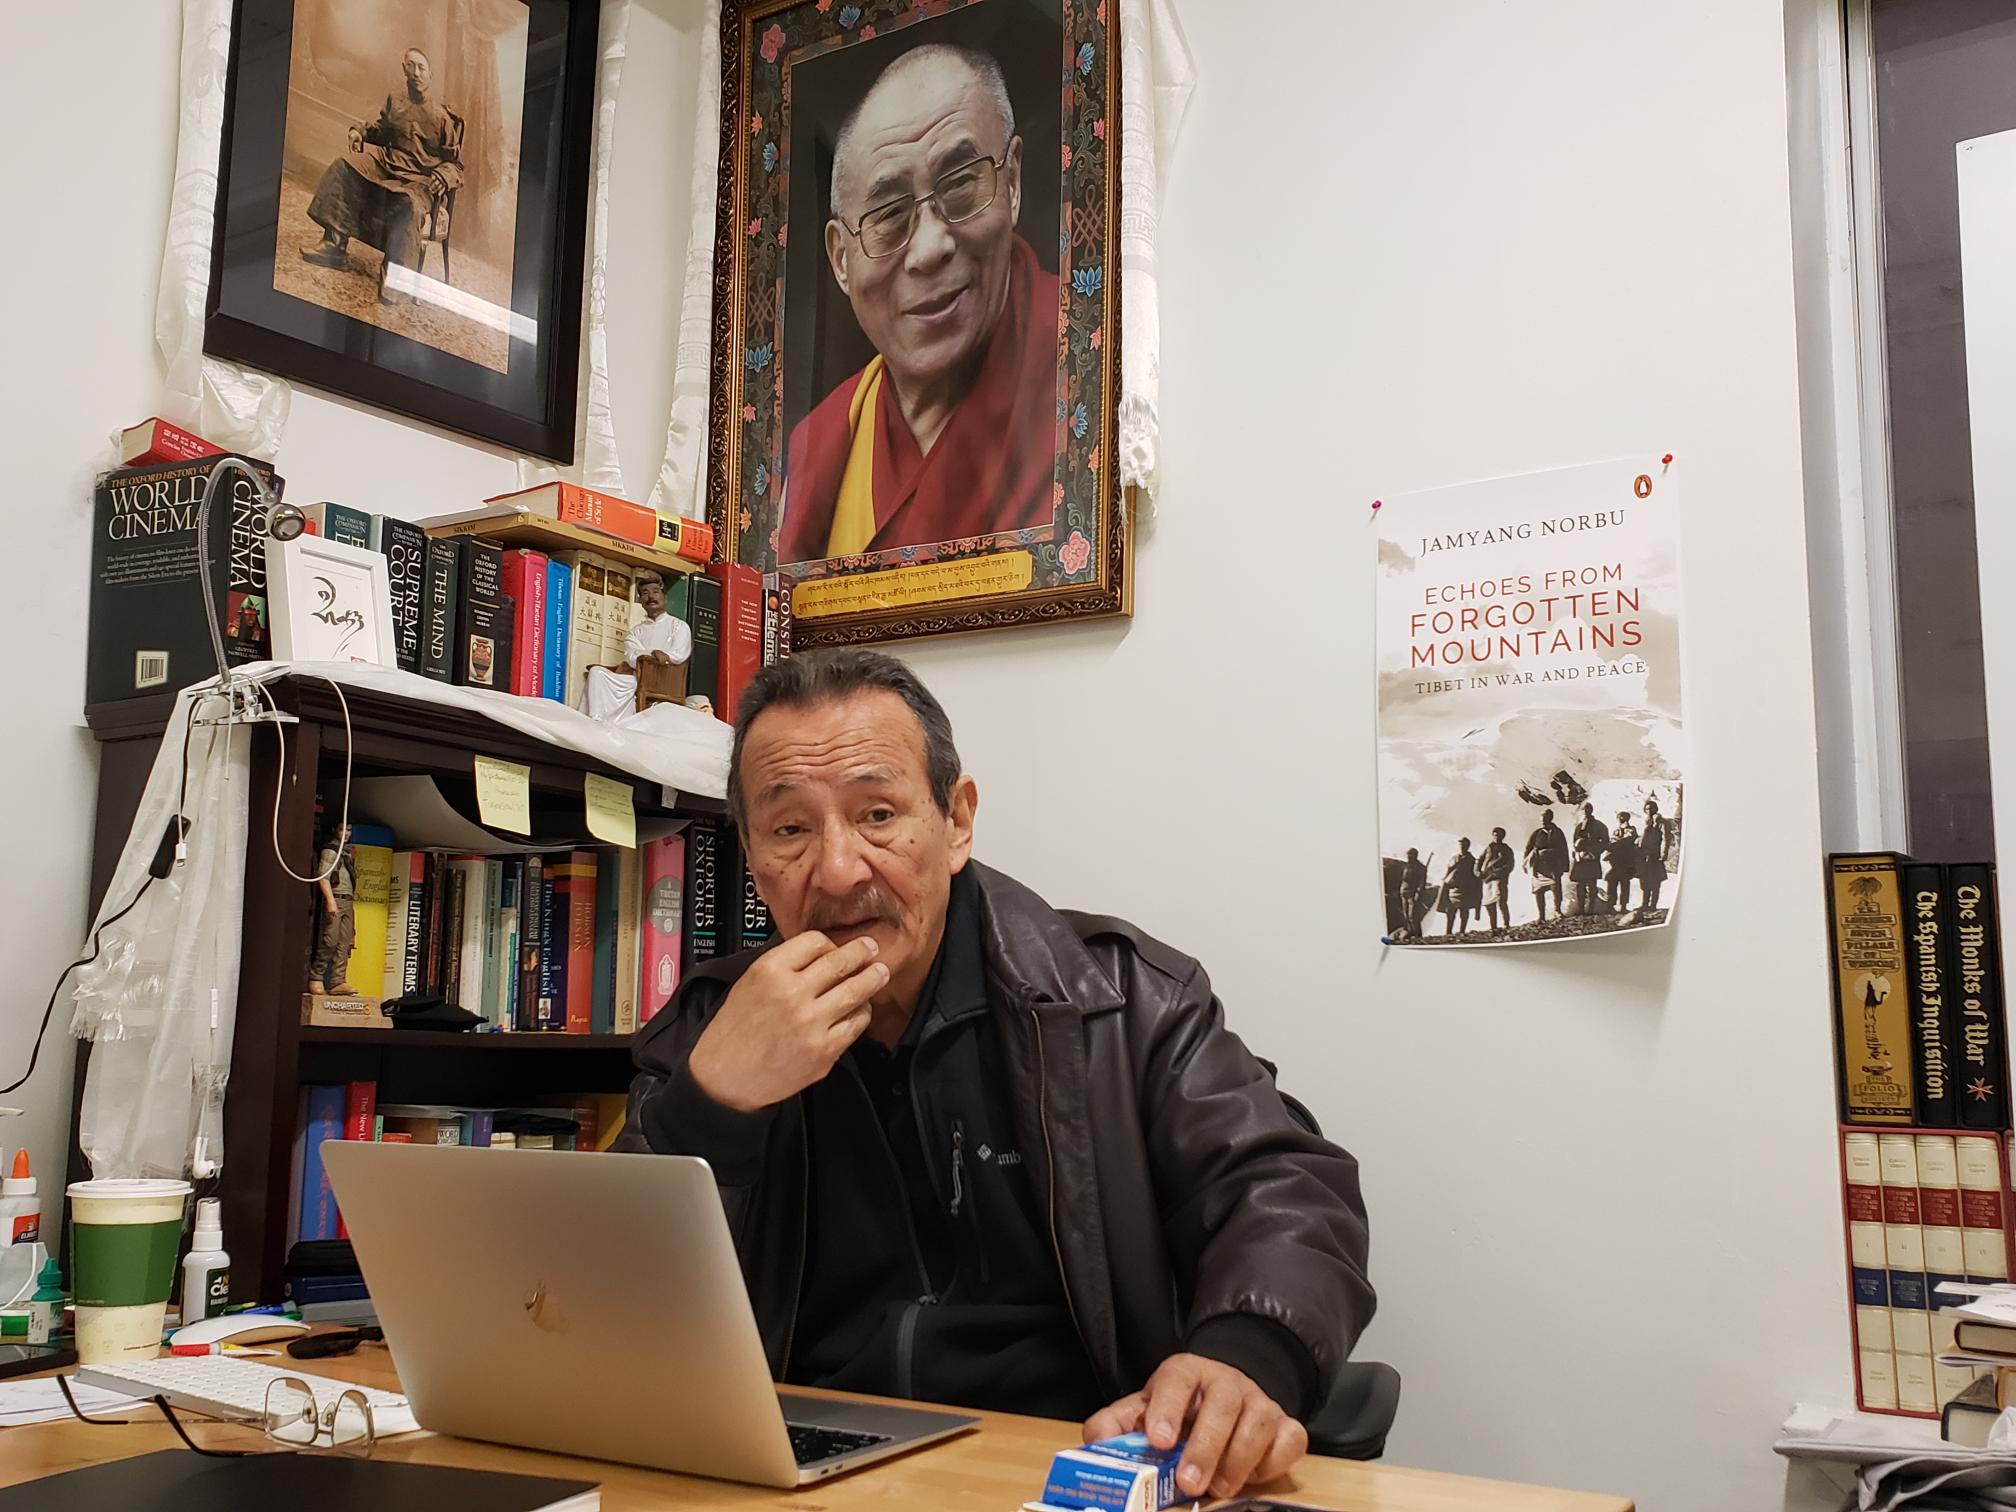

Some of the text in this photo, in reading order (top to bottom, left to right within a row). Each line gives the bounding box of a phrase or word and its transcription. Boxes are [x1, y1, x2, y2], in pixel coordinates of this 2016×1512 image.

[111, 464, 213, 488] THE OXFORD HISTORY OF
[110, 475, 210, 516] WORLD
[567, 501, 575, 515] The
[585, 494, 593, 521] Manual
[594, 498, 602, 525] of Style
[230, 480, 252, 587] CINEMA
[249, 494, 268, 589] WORLD
[403, 528, 423, 539] OXFORD
[453, 524, 476, 533] SIKKIM
[661, 521, 672, 538] 14th
[1420, 509, 1626, 558] JAMYANG NORBU
[432, 546, 455, 558] OXFORD
[480, 553, 491, 561] THE
[611, 540, 635, 553] SIKKIM
[475, 559, 497, 569] OXFORD
[475, 566, 496, 576] HISTORY
[390, 544, 406, 626] COURT
[434, 569, 448, 605] THE
[472, 579, 499, 590] CLASSICAL
[476, 587, 495, 596] WORLD
[484, 575, 494, 583] THE
[1425, 563, 1623, 605] ECHOES FROM
[403, 548, 422, 650] SUPREME
[532, 572, 543, 626] English-Tibetan
[1411, 587, 1640, 638] FORGOTTEN
[431, 607, 446, 659] MIND
[531, 626, 541, 664] Dictionary
[1411, 620, 1643, 669] MOUNTAINS
[531, 665, 539, 674] of
[1416, 660, 1647, 694] TIBET IN WAR AND PEACE
[695, 835, 706, 927] OXFORD
[704, 836, 716, 927] SHORTER
[659, 898, 680, 907] ENGLISH
[406, 900, 421, 952] LITERARY
[542, 881, 553, 995] The King's English
[574, 902, 583, 952] JOBSON
[1850, 929, 1886, 938] SEVEN
[693, 938, 716, 947] ENGLISH
[1846, 941, 1895, 950] PILLARS
[1863, 951, 1877, 959] OF
[404, 953, 419, 993] TERMS
[1956, 884, 1991, 1067] The Monks of War
[1913, 890, 1949, 1100] The Spanish Inquisition
[361, 1096, 369, 1112] The
[359, 1113, 368, 1133] New
